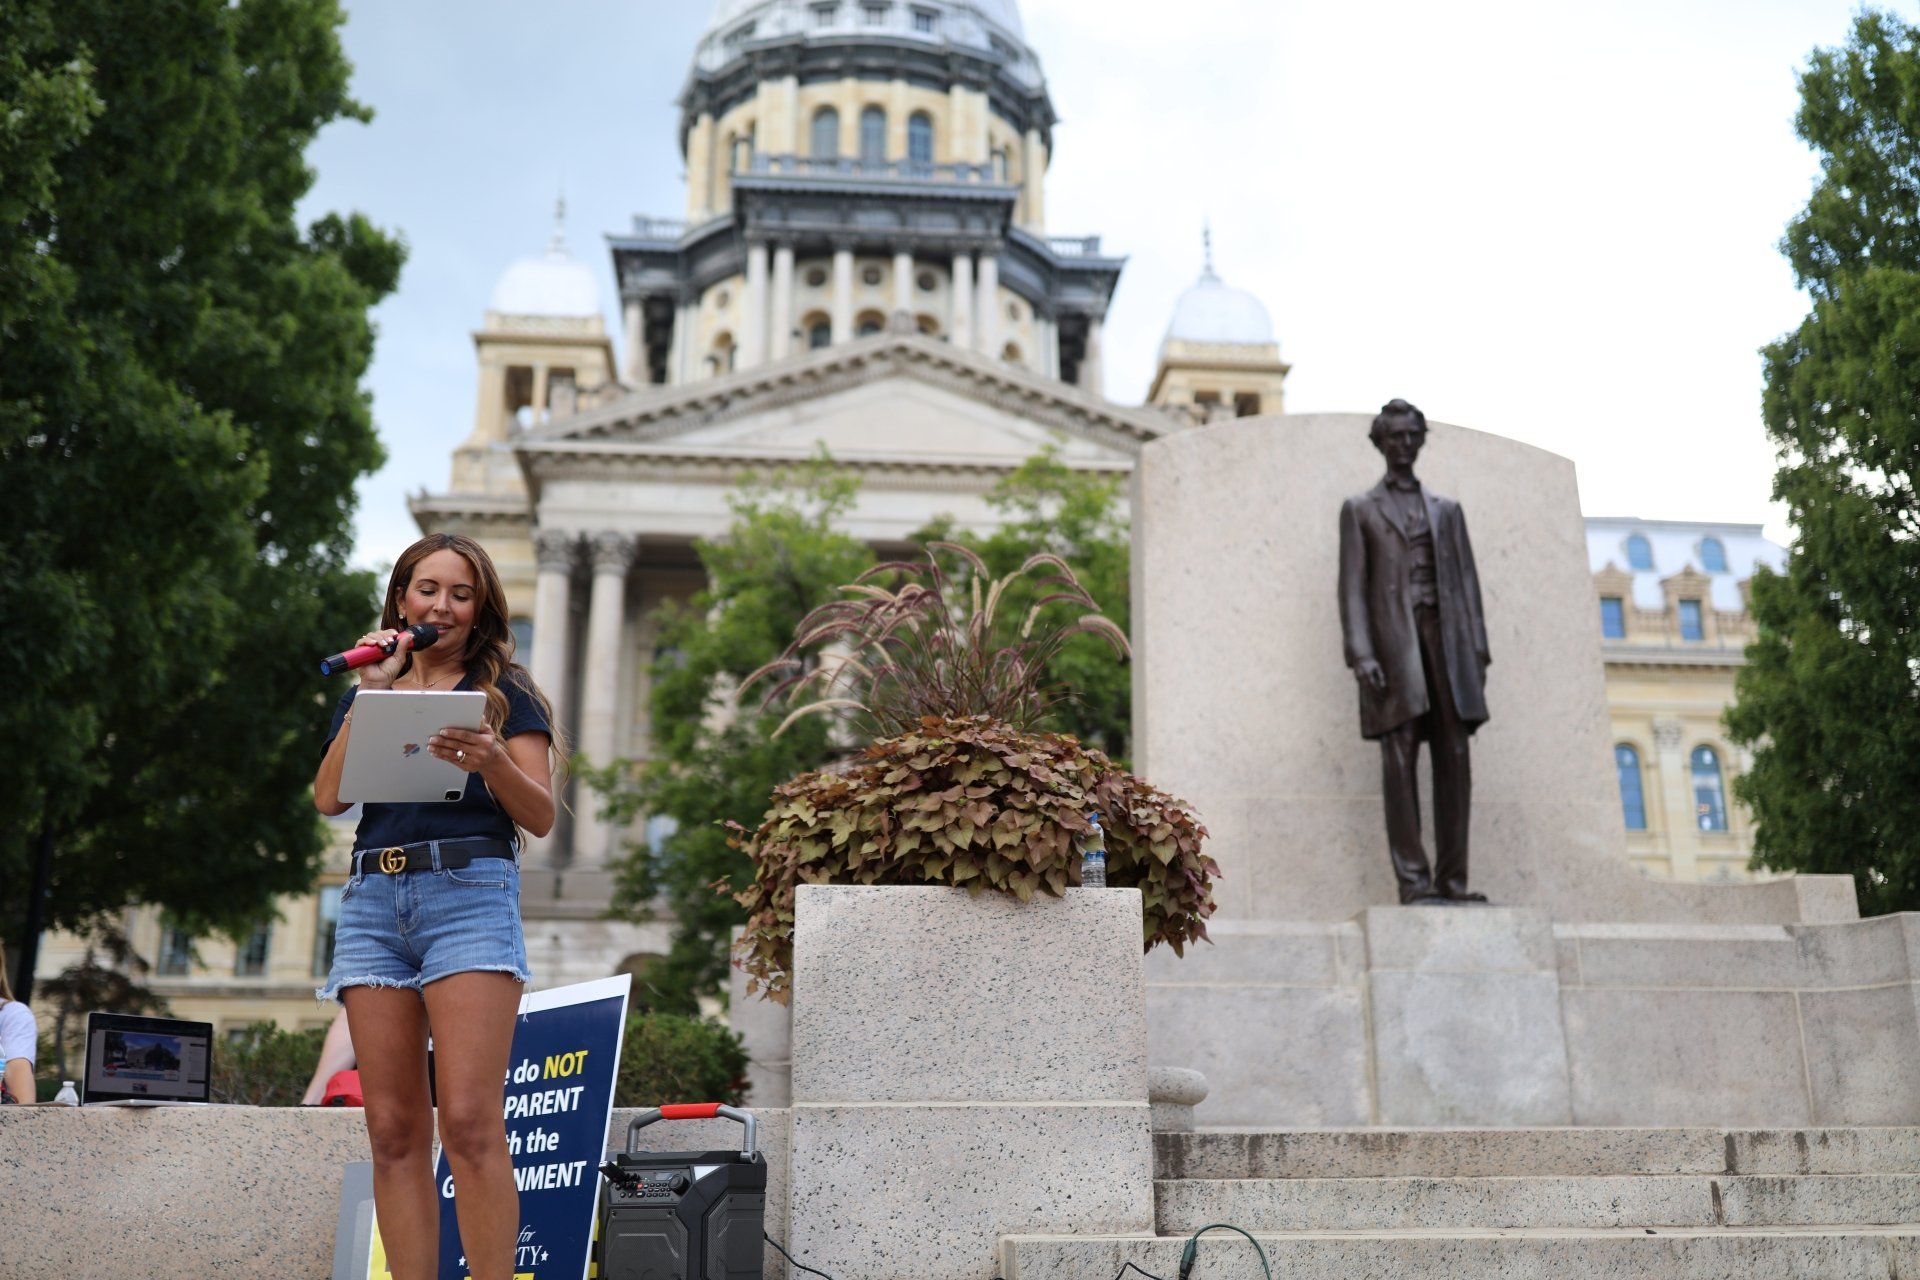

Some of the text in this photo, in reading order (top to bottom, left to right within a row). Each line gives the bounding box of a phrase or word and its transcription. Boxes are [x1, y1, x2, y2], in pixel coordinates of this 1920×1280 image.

[513, 1058, 540, 1084] do
[543, 1049, 589, 1080] NOT
[503, 1085, 585, 1120] PARENT
[526, 1126, 560, 1154] the
[516, 1224, 537, 1245] for
